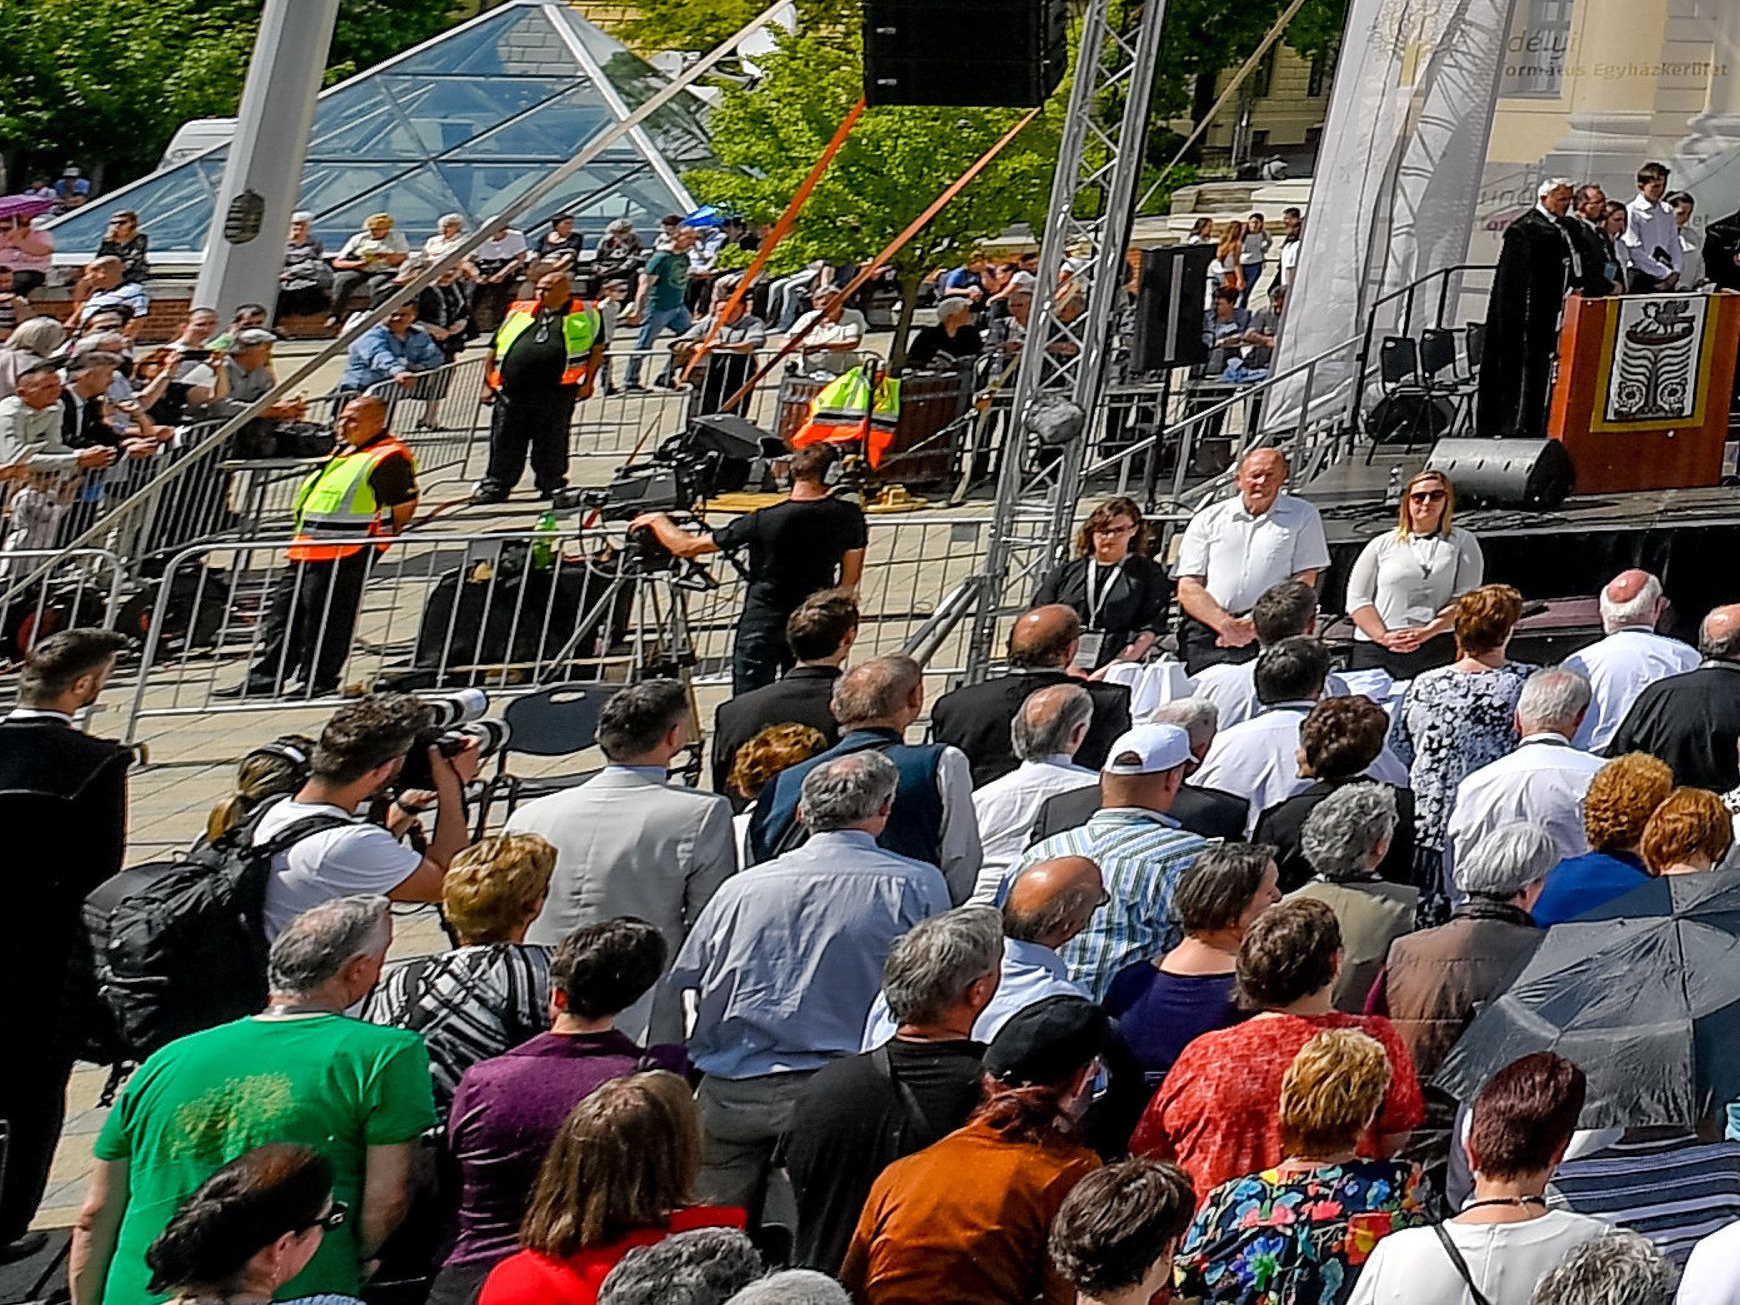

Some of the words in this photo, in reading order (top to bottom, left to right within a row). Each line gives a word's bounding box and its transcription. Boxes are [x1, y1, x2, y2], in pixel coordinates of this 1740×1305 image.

[1506, 28, 1579, 59] délyi
[1504, 61, 1586, 78] ormátus
[1593, 61, 1730, 81] Egyházkerület
